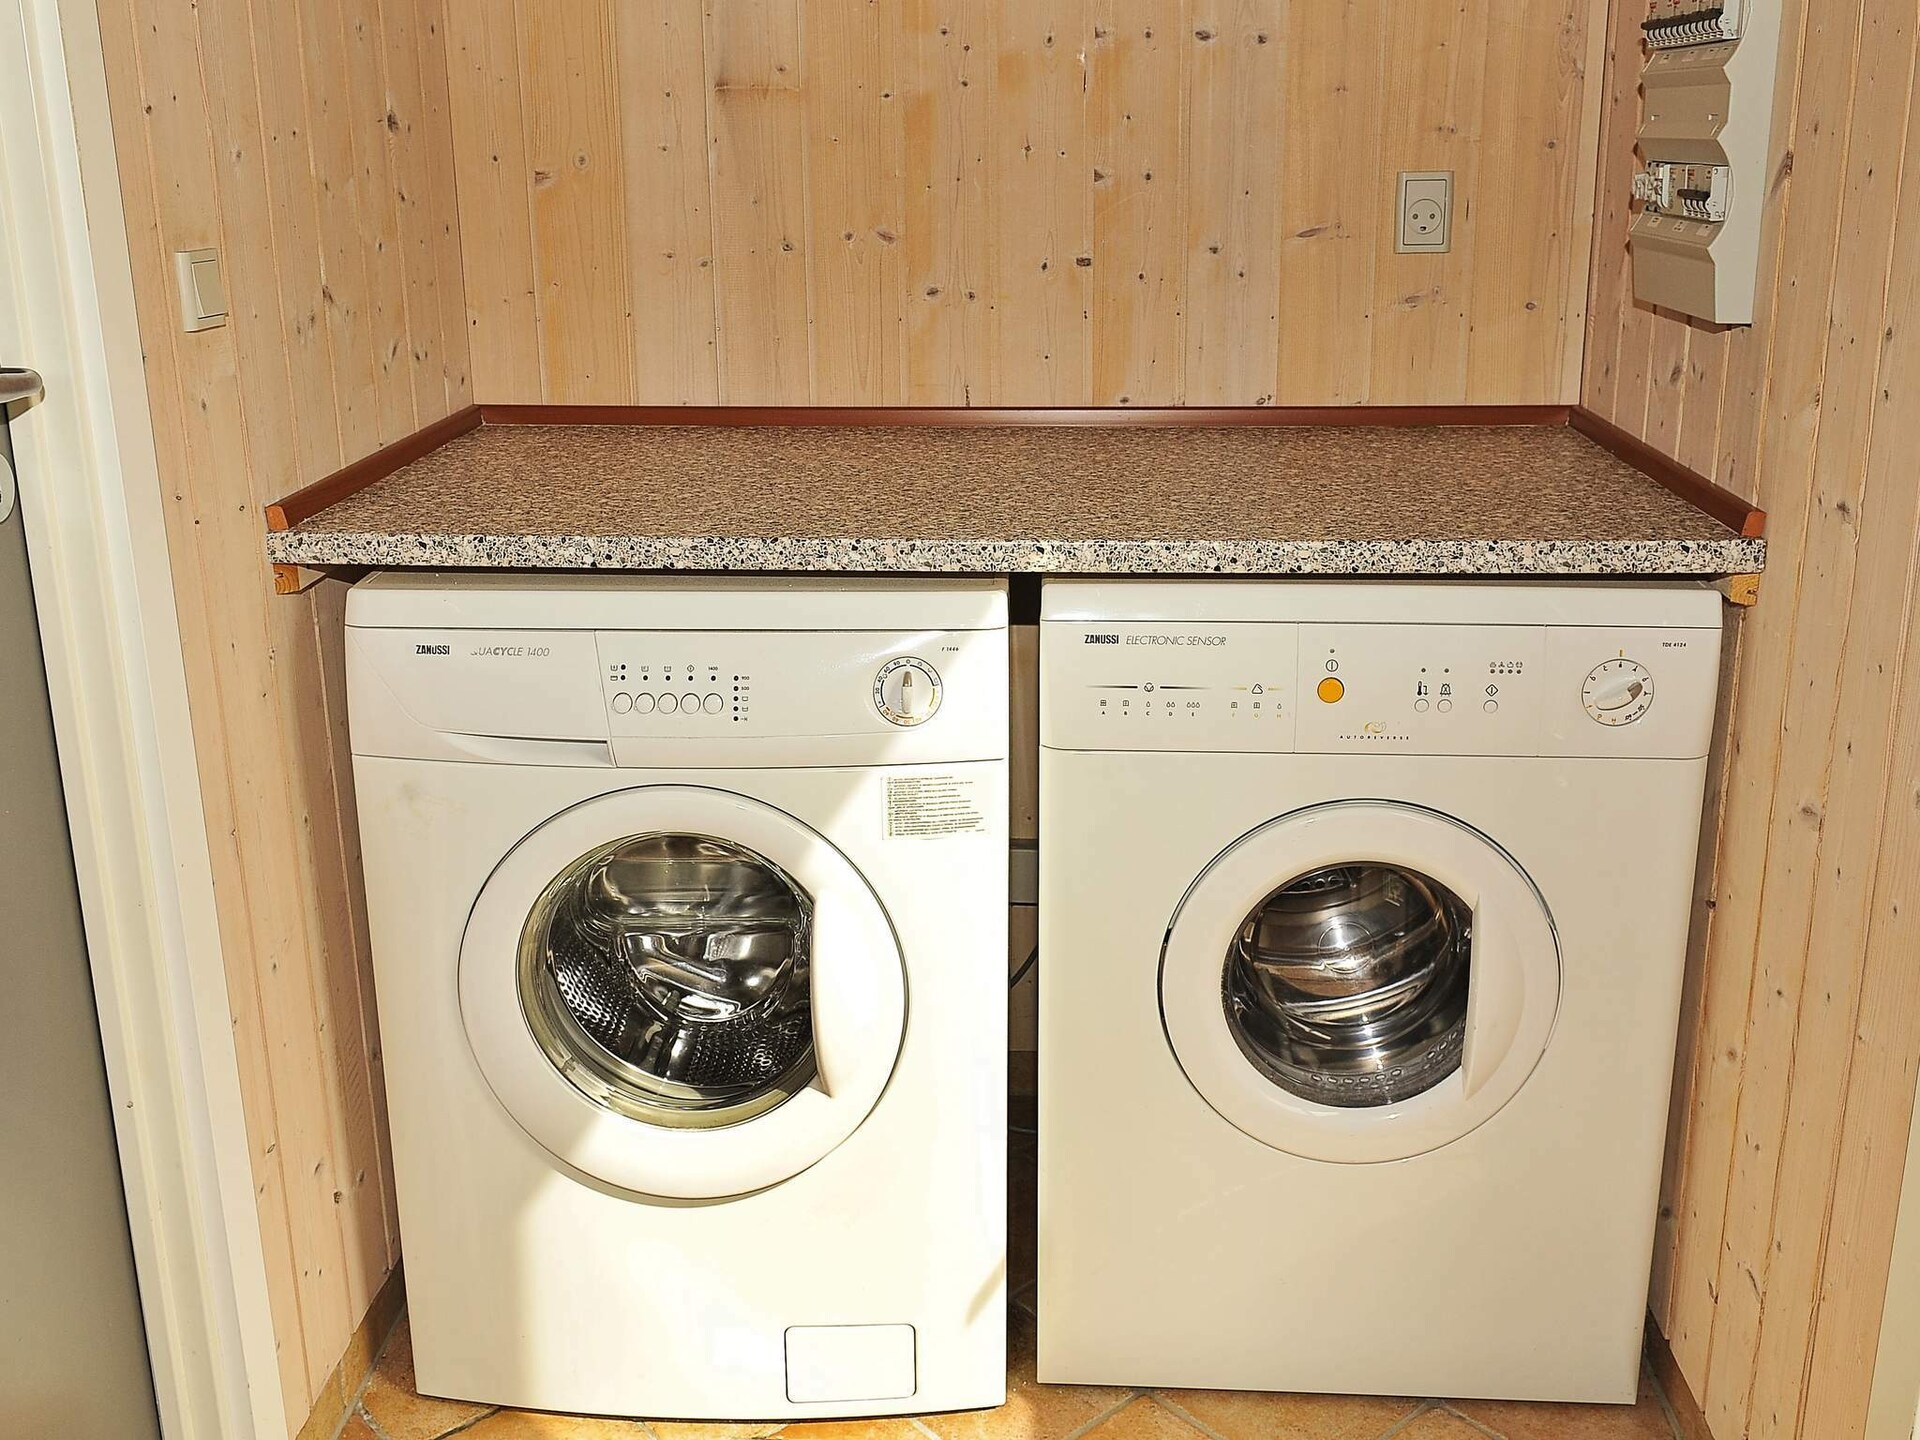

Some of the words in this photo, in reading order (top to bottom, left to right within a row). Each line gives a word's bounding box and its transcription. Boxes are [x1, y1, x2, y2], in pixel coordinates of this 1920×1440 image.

[1084, 634, 1119, 645] ZANUSSI
[1126, 635, 1185, 646] ELECTRONIC
[1186, 636, 1227, 647] SENSOR
[415, 644, 450, 655] ZANUSSI
[470, 647, 523, 657] UACYCLE
[527, 647, 550, 657] 1400
